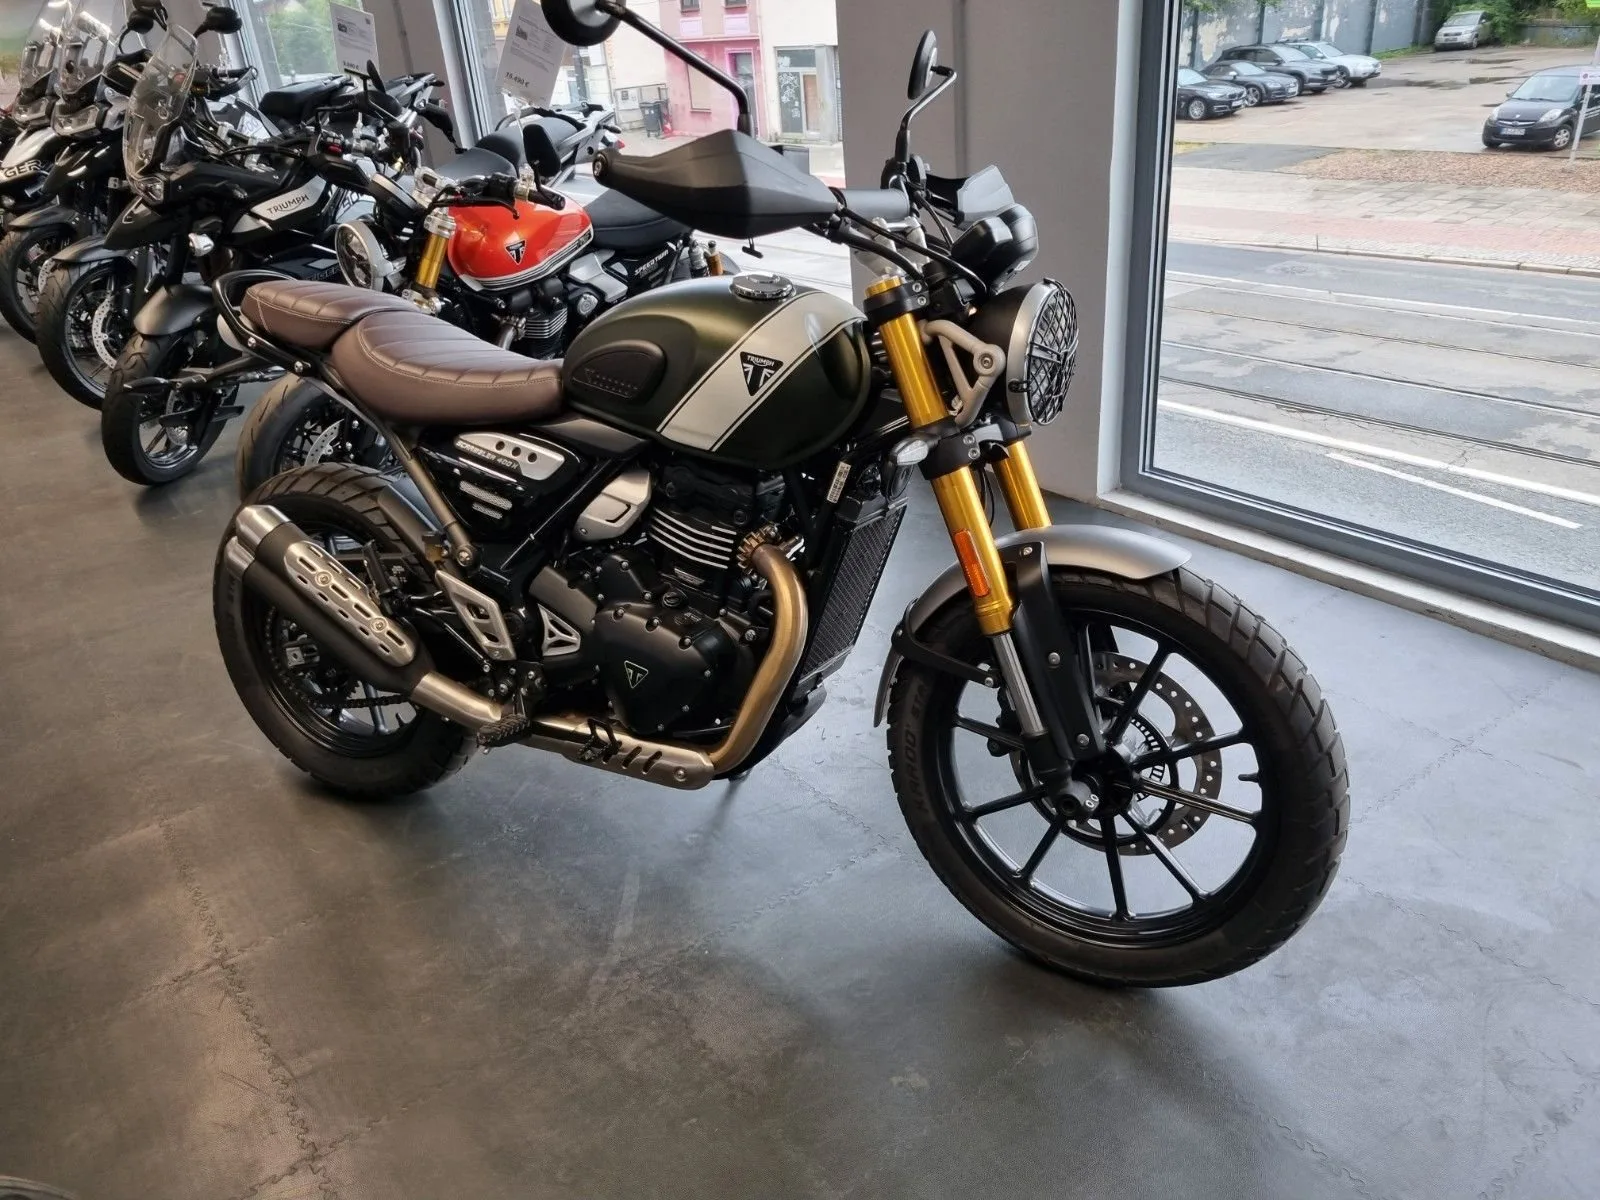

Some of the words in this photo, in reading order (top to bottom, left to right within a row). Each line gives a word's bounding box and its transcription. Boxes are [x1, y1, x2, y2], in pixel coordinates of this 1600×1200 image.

[266, 193, 310, 214] TRIUMPH
[634, 259, 655, 276] SPEED
[747, 355, 775, 367] TRIUMPH
[456, 440, 497, 461] SCRAMBLER
[497, 458, 513, 467] 400
